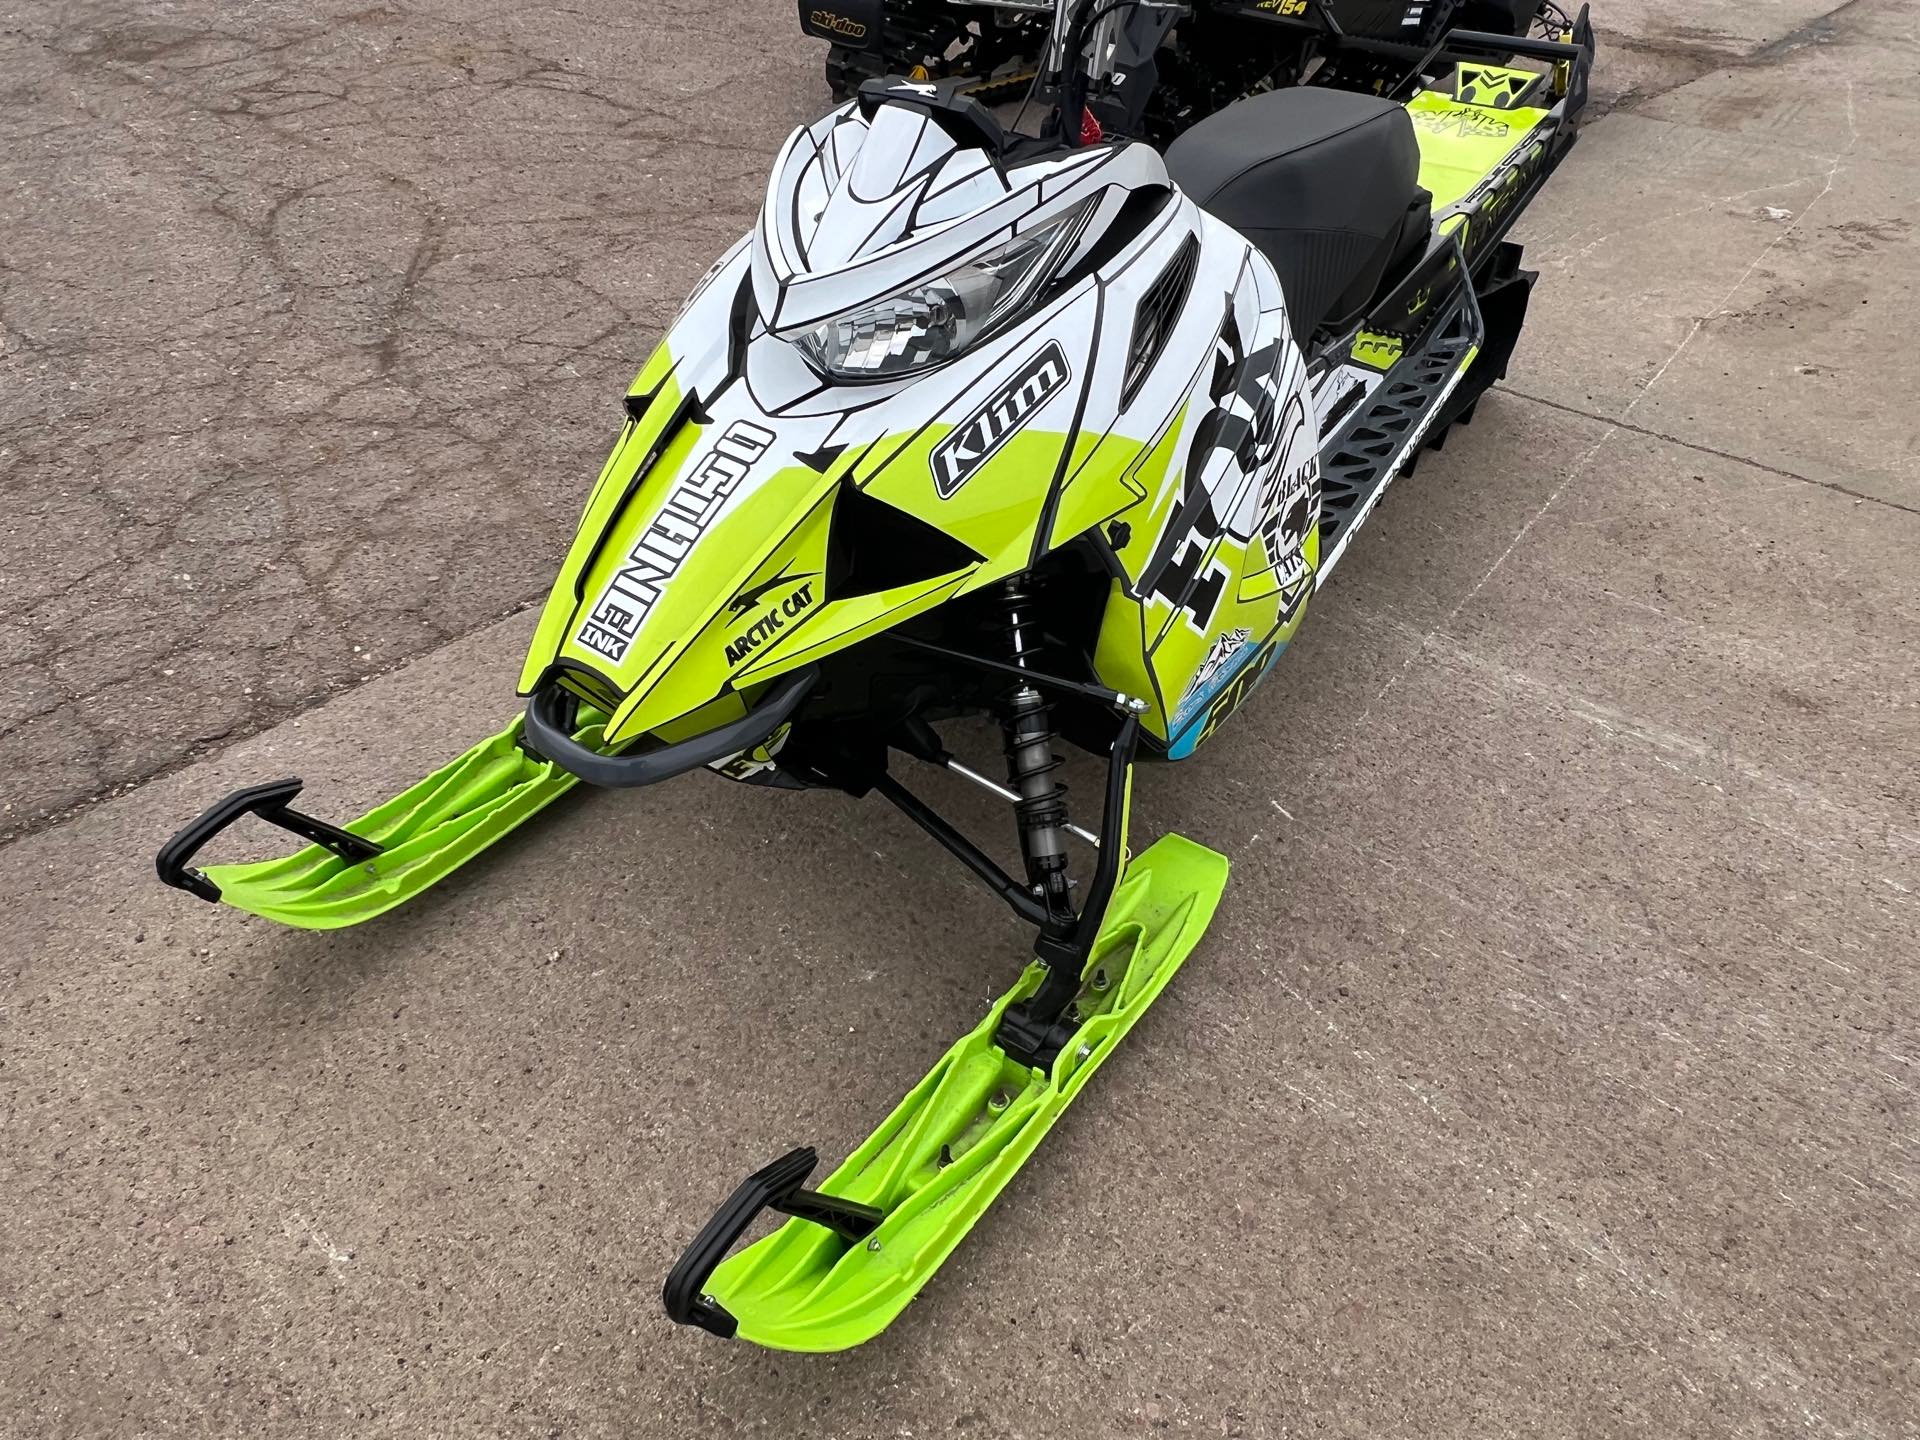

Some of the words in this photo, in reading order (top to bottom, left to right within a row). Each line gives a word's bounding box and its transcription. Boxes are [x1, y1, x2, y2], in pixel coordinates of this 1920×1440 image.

[1277, 0, 1308, 15] 154
[1136, 291, 1288, 636] FOX
[1278, 455, 1318, 504] BLACK
[589, 419, 777, 638] OCTANE
[1276, 553, 1304, 587] CATS
[580, 624, 627, 661] INK
[724, 607, 785, 669] ARCTIC
[782, 583, 813, 621] CAT
